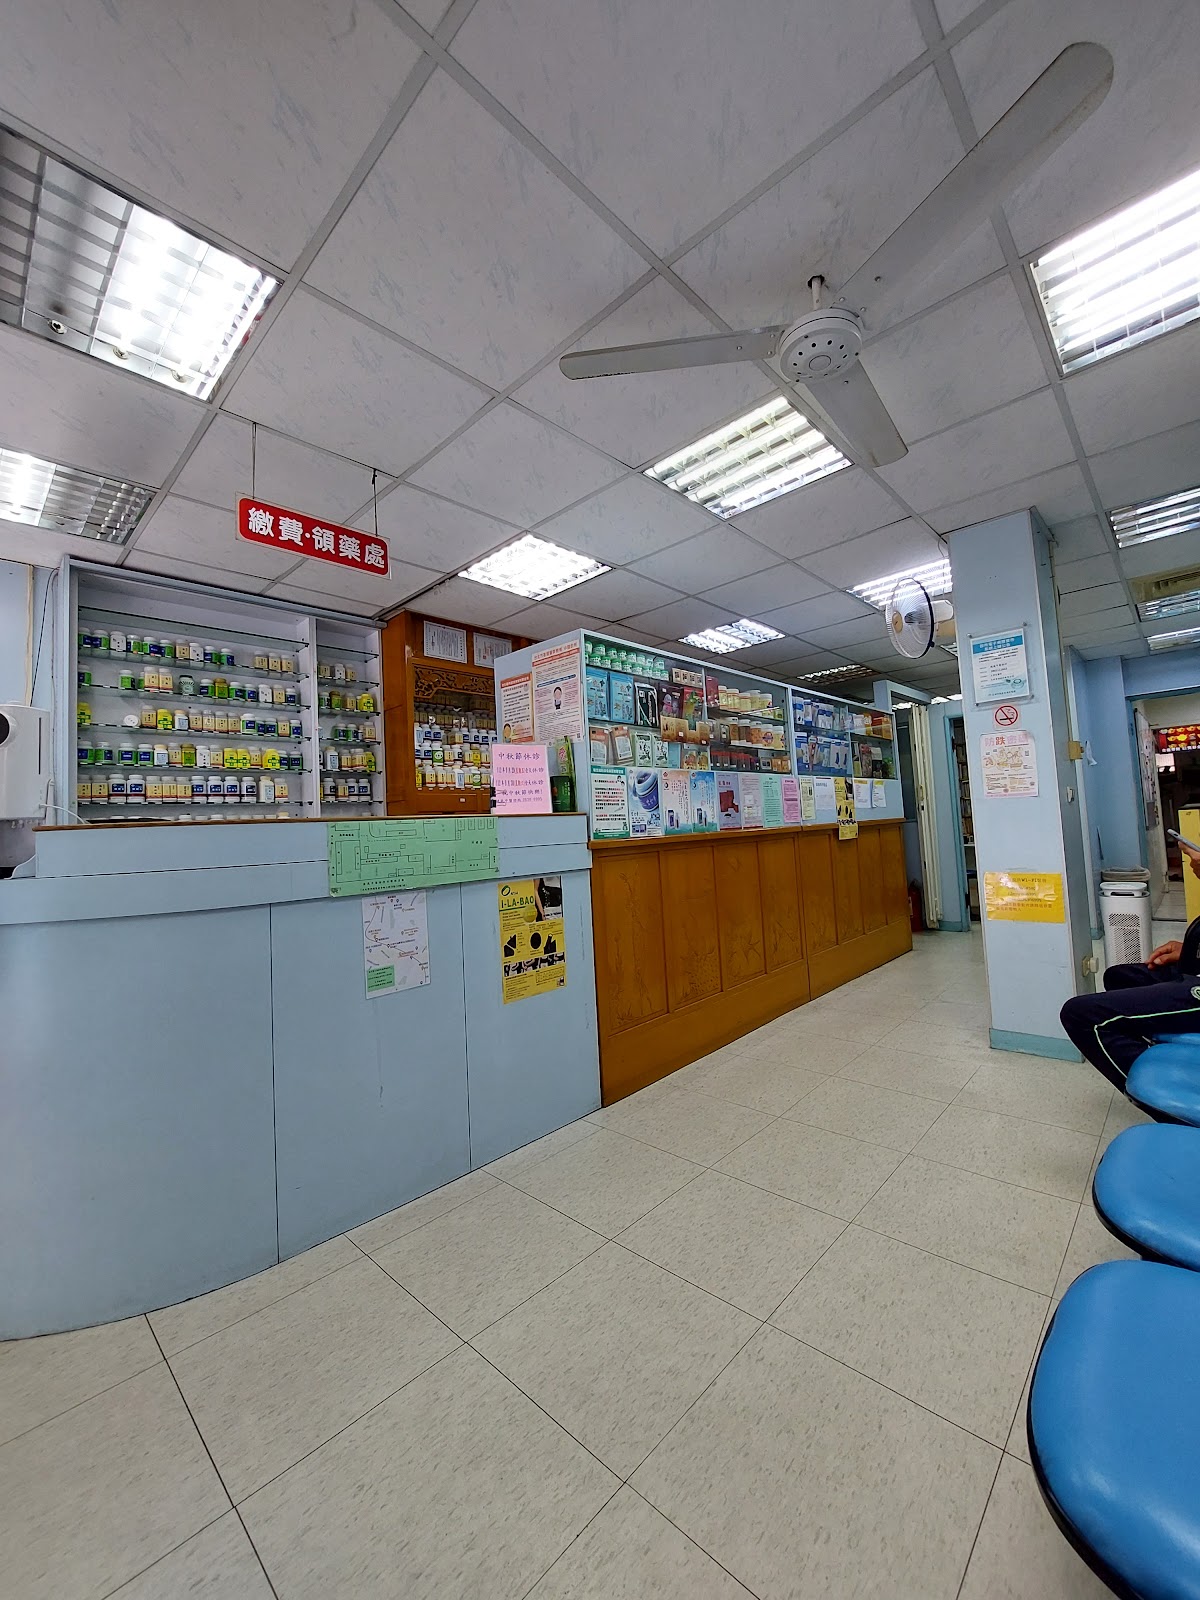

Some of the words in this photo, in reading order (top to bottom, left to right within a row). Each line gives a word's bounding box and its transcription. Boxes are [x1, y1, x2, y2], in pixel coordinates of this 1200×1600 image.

[248, 507, 385, 569] 繳費·領藥處
[498, 751, 540, 761] 中秋節休診
[501, 896, 534, 909] I-LA-BAO
